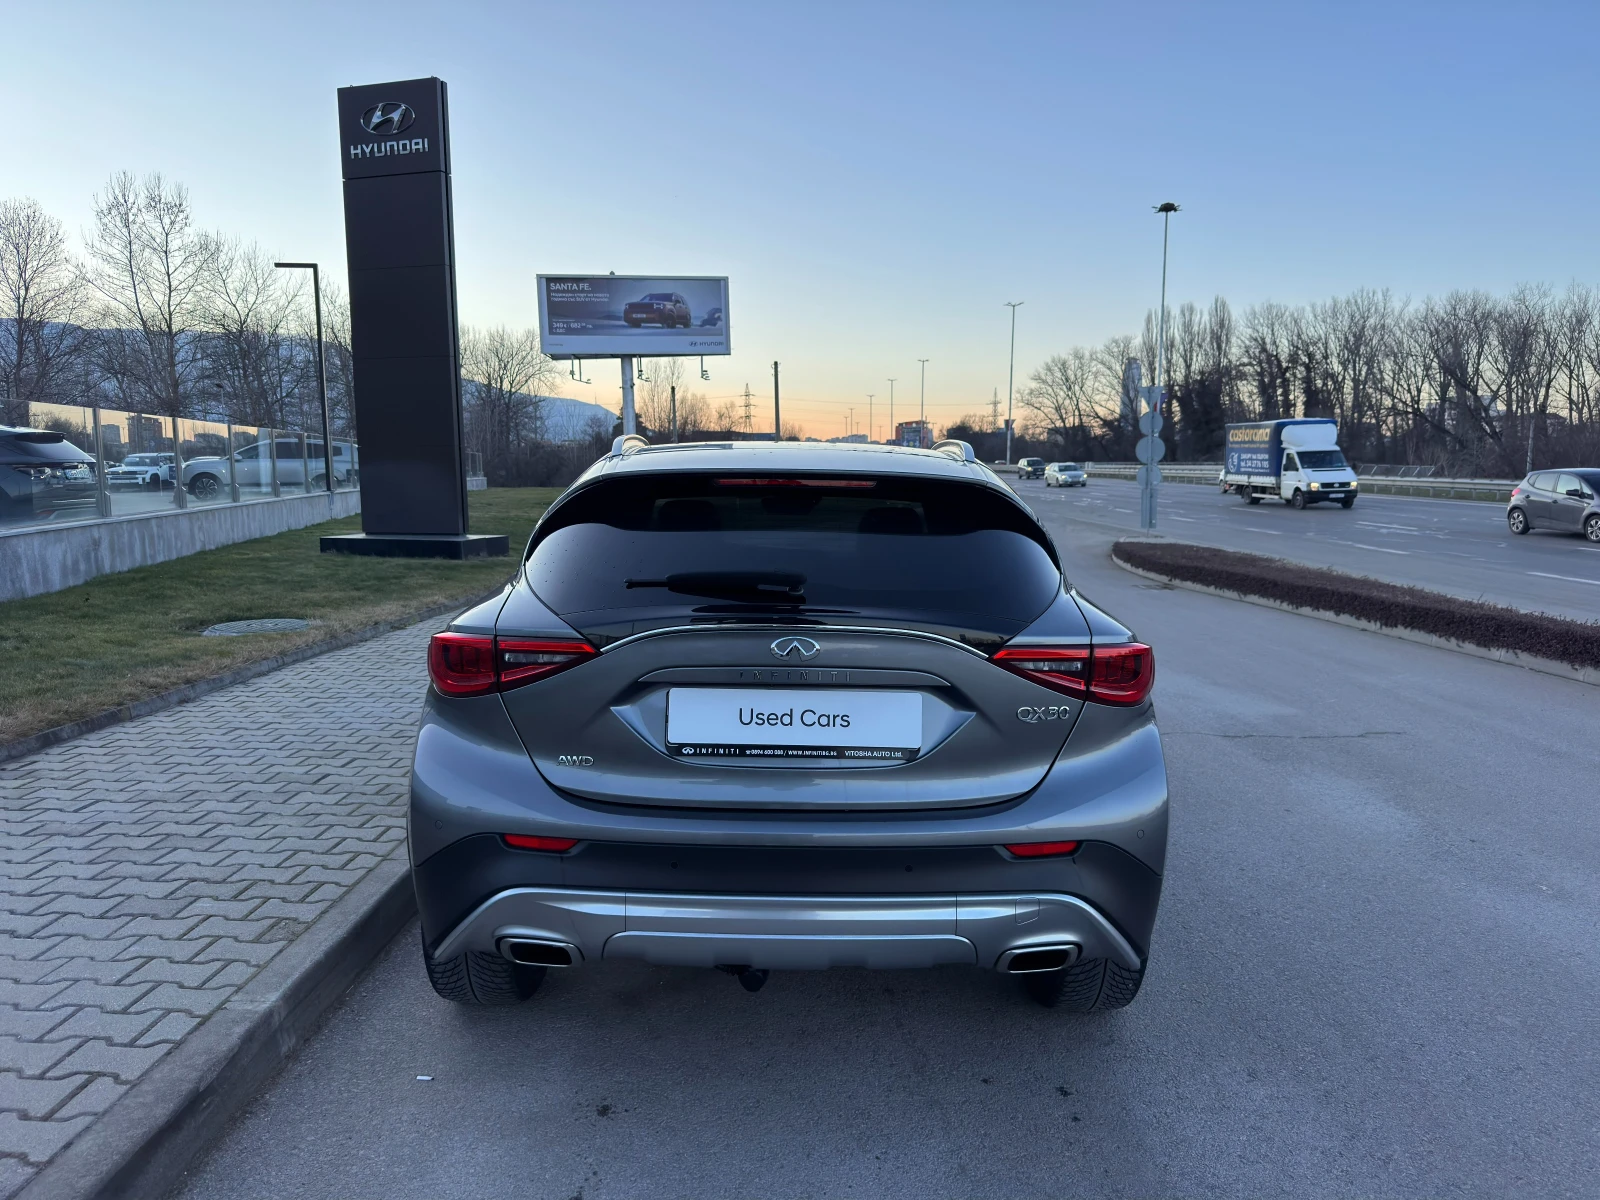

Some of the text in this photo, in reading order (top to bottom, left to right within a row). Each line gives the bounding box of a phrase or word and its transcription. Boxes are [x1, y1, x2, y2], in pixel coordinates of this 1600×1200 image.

[350, 138, 429, 159] HYUNDAI
[579, 283, 592, 291] FE.
[1229, 428, 1270, 442] castorama
[740, 670, 850, 682] INFINITI
[739, 708, 851, 728] Used Cars
[1017, 705, 1070, 724] QX30
[556, 755, 594, 766] AWD
